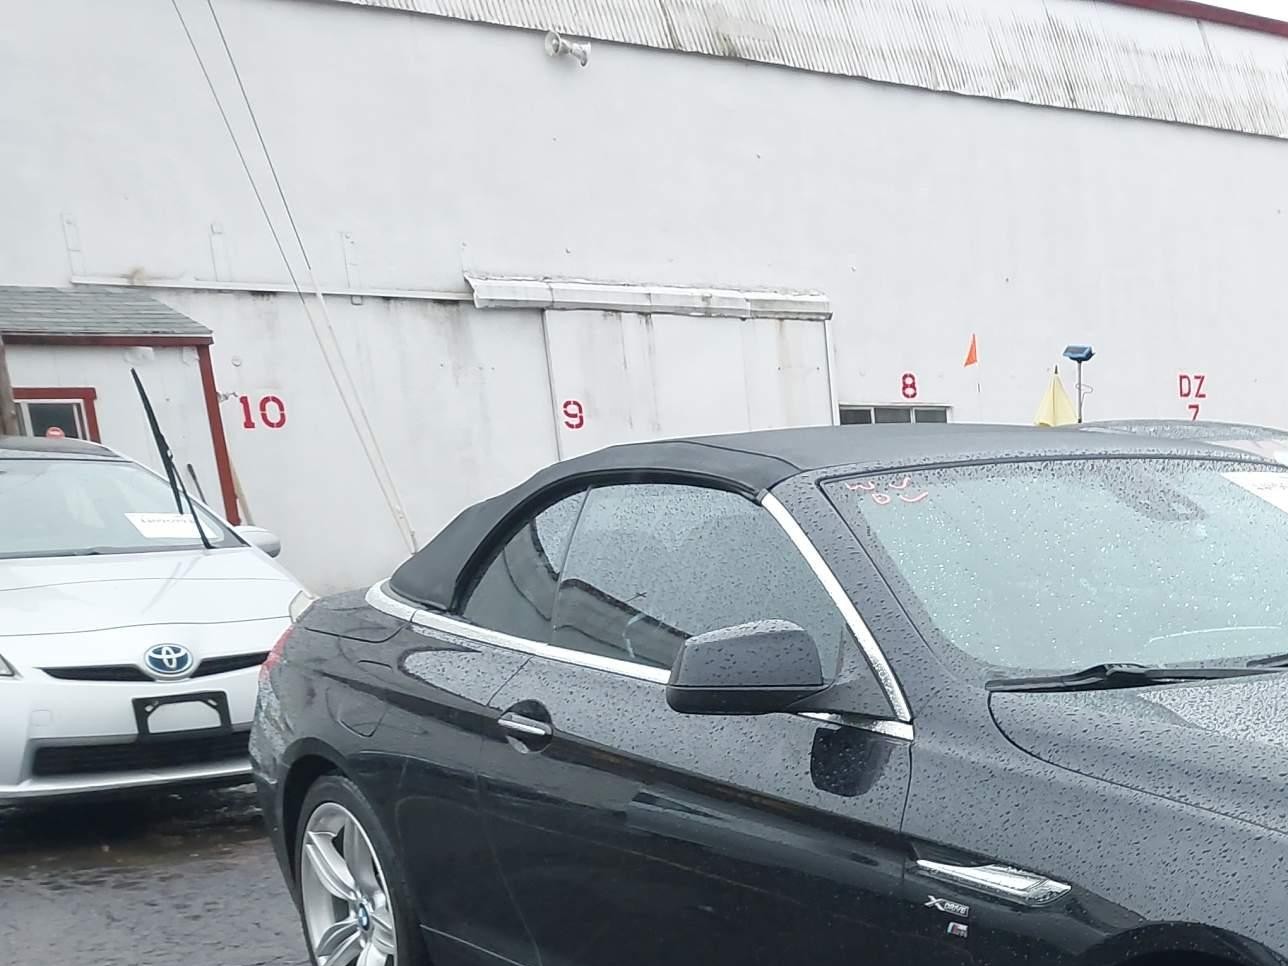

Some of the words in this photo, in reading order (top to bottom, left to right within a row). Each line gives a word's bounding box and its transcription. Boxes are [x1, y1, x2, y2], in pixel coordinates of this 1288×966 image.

[902, 373, 917, 399] 8
[1179, 374, 1207, 399] DZ
[239, 395, 287, 430] 10
[562, 399, 585, 430] 9
[1188, 404, 1200, 421] 7
